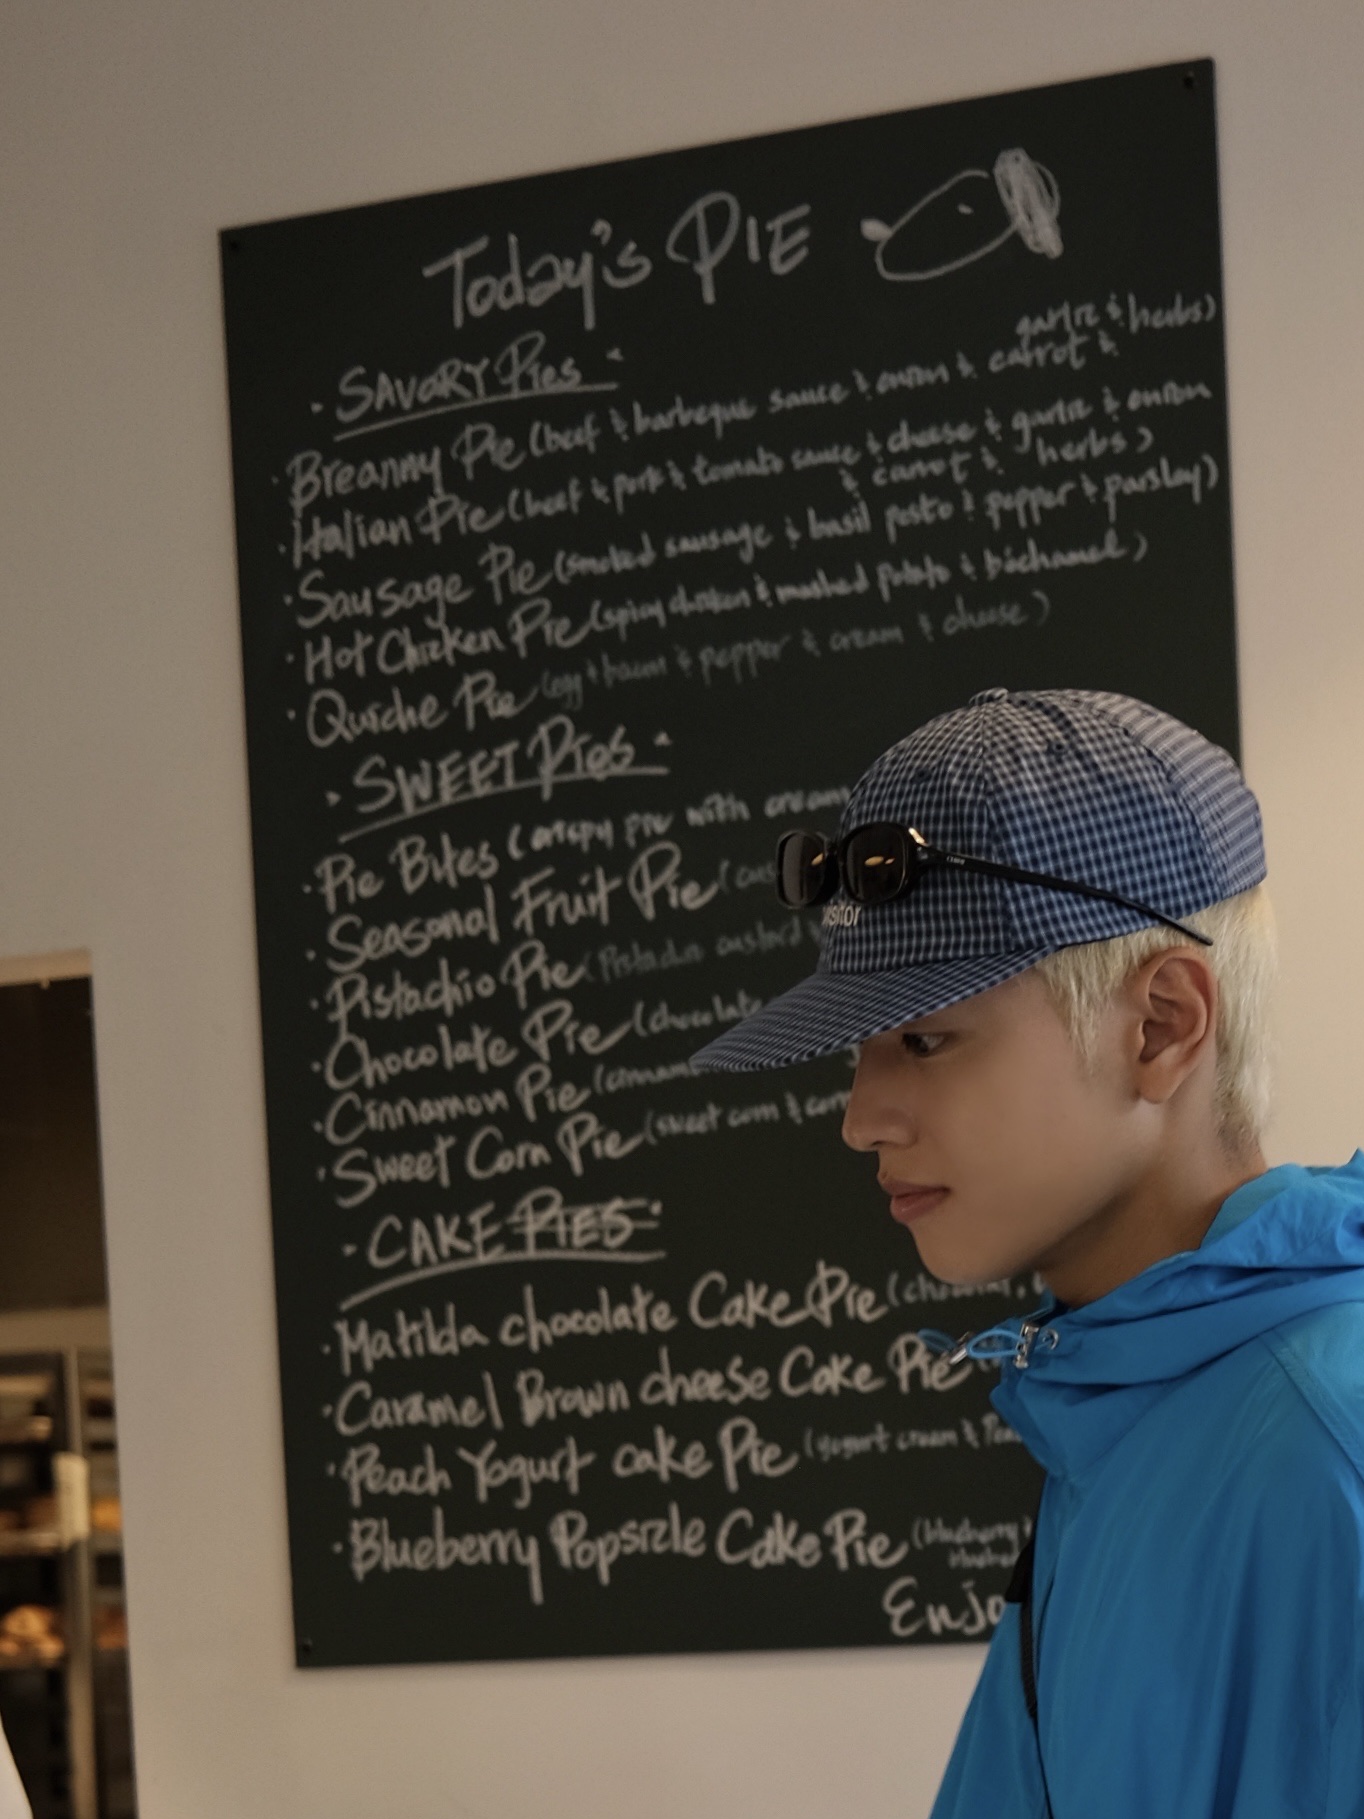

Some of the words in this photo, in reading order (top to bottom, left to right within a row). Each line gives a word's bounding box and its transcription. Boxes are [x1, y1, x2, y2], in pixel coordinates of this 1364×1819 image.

[423, 218, 653, 331] Today's
[666, 190, 811, 304] PIE
[493, 330, 582, 398] Pies
[286, 445, 444, 506] Breanny
[450, 422, 526, 481] Pie
[767, 381, 850, 414] sauce
[876, 360, 950, 395] onion
[988, 335, 1090, 371] carrot
[871, 450, 973, 488] carrot
[290, 506, 414, 569] Italian
[416, 494, 505, 545] Pie
[613, 464, 665, 516] pork
[692, 444, 784, 486] tomato
[790, 443, 861, 472] sauce
[886, 417, 977, 453] cheese
[1011, 397, 1095, 454] garlic
[1127, 380, 1213, 412] onion
[296, 569, 474, 629] Sausage
[478, 541, 553, 606] Pie
[665, 522, 775, 565] sausage
[806, 500, 872, 540] basil
[885, 492, 955, 545] pesto
[985, 481, 1077, 532] pepper
[304, 629, 373, 685] Hot
[376, 623, 506, 674] Chicken
[507, 598, 592, 659] Pie
[668, 584, 751, 617] chicken
[774, 560, 870, 605] mashed
[876, 554, 951, 603] potato
[306, 686, 449, 749] Quiche
[452, 669, 540, 731] Pie
[699, 632, 792, 688] pepper
[829, 623, 904, 651] cream
[352, 740, 520, 816] SWEET
[527, 714, 635, 801] Pies
[314, 852, 385, 913] Pie
[389, 832, 500, 894] Bites
[686, 792, 751, 827] with
[326, 883, 498, 974] Seasonal
[511, 864, 622, 937] Fruit
[628, 841, 719, 921] Pie
[324, 956, 498, 1030] Pistachio
[500, 937, 587, 1010] Pie
[324, 1022, 518, 1092] Chocolate
[520, 998, 635, 1061] Pie
[324, 1085, 511, 1147] Cinnamon
[514, 1062, 592, 1122] Pie
[333, 1133, 457, 1209] Sweet
[465, 1124, 552, 1181] Corn
[555, 1111, 645, 1177] Pie
[367, 1201, 506, 1271] CAKE
[506, 1186, 636, 1252] PIES
[334, 1301, 490, 1376] Matilda
[499, 1282, 680, 1352] chocolate
[689, 1270, 805, 1329] Cake
[804, 1259, 890, 1327] Pie
[336, 1370, 503, 1436] Caramel
[515, 1368, 632, 1427] Brown
[639, 1345, 771, 1405] cheese
[779, 1345, 886, 1397] Cake
[887, 1331, 973, 1395] Pie
[342, 1442, 452, 1509] Peach
[457, 1434, 597, 1509] Yogurt
[612, 1424, 714, 1484] cake
[718, 1414, 799, 1493] Pie
[895, 1427, 959, 1451] cream
[350, 1506, 544, 1606] Blueberry
[715, 1507, 822, 1569] Cake
[823, 1507, 910, 1571] Pie
[882, 1574, 1005, 1637] Enjo
